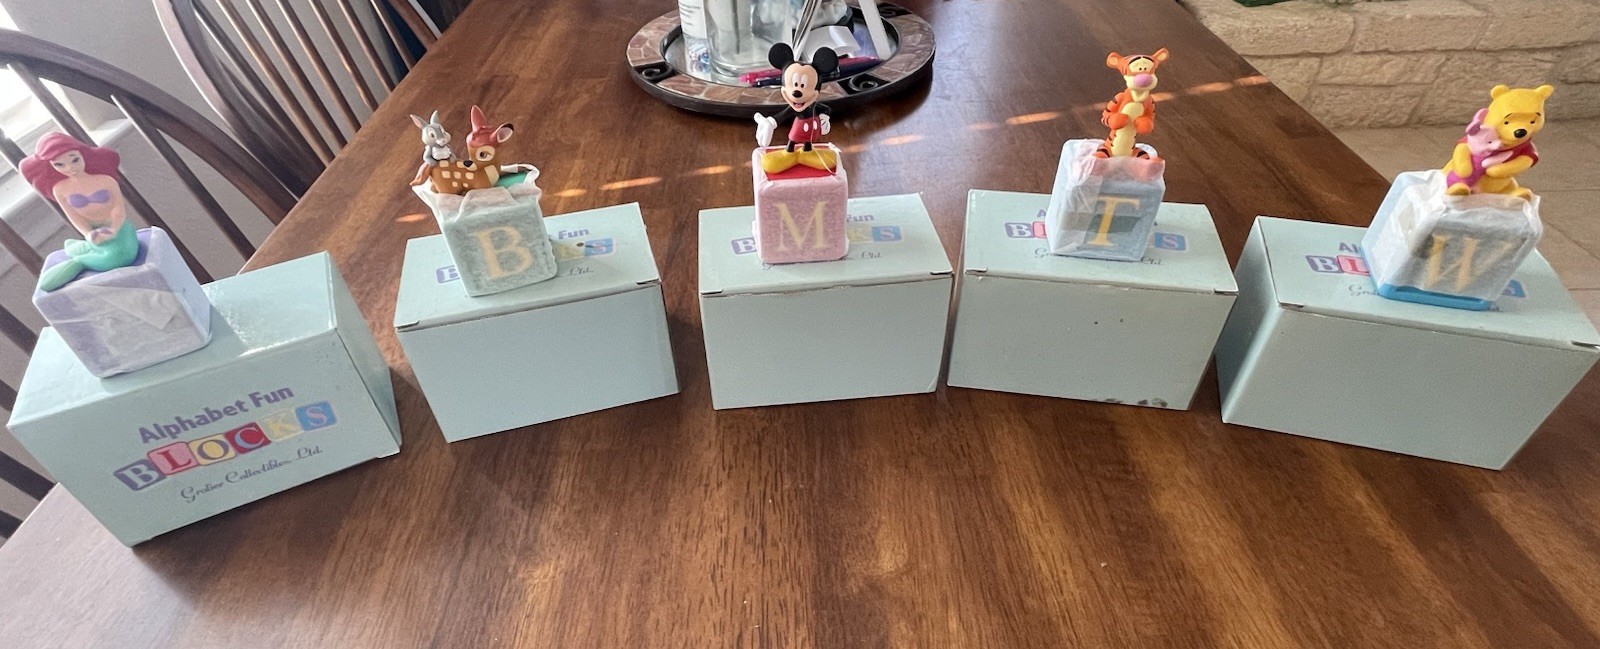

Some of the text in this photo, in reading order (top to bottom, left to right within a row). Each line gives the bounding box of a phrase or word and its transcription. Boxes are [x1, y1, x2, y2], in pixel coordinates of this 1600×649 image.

[558, 228, 590, 240] Fun
[772, 200, 835, 251] M
[1086, 194, 1142, 247] T
[469, 224, 534, 282] B
[1420, 233, 1519, 294] W
[138, 386, 295, 444] Alphabet Fun
[115, 402, 335, 490] BLOCKS
[181, 481, 224, 503] Grolier
